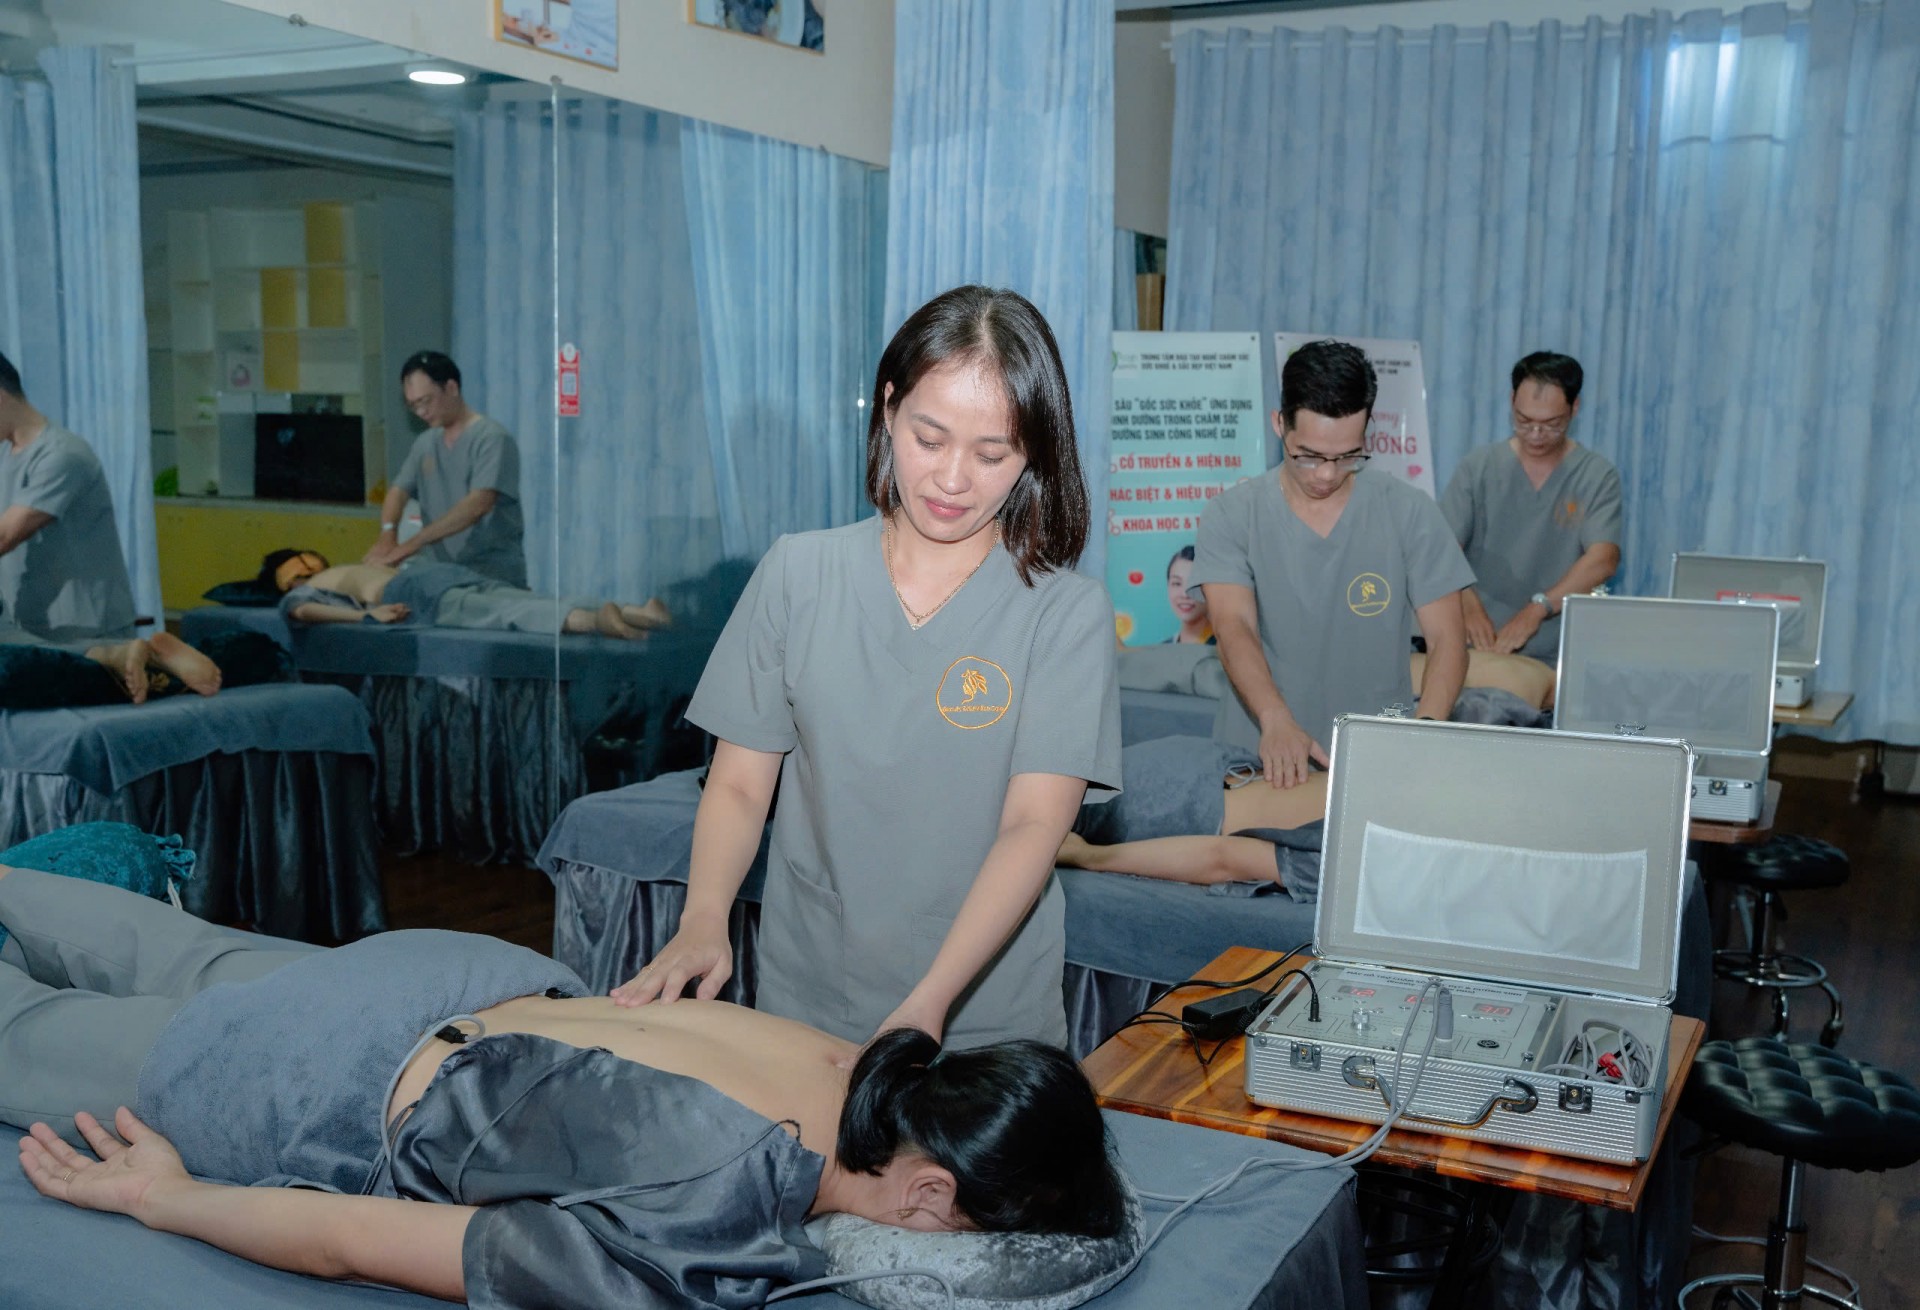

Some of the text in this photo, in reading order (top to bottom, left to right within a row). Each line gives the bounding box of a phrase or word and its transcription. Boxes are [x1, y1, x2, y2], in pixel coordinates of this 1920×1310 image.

[1163, 414, 1192, 426] TRONG
[1144, 429, 1166, 440] SINH
[1167, 427, 1193, 440] CÔNG
[1220, 428, 1237, 439] CAO
[1184, 456, 1193, 468] &
[1196, 452, 1222, 472] HIỆN
[1135, 484, 1160, 503] BIỆT
[1164, 487, 1172, 500] &
[1176, 484, 1201, 502] HIỆU
[1123, 518, 1153, 531] KHOA
[1156, 517, 1180, 532] HỌC
[1184, 517, 1191, 529] &
